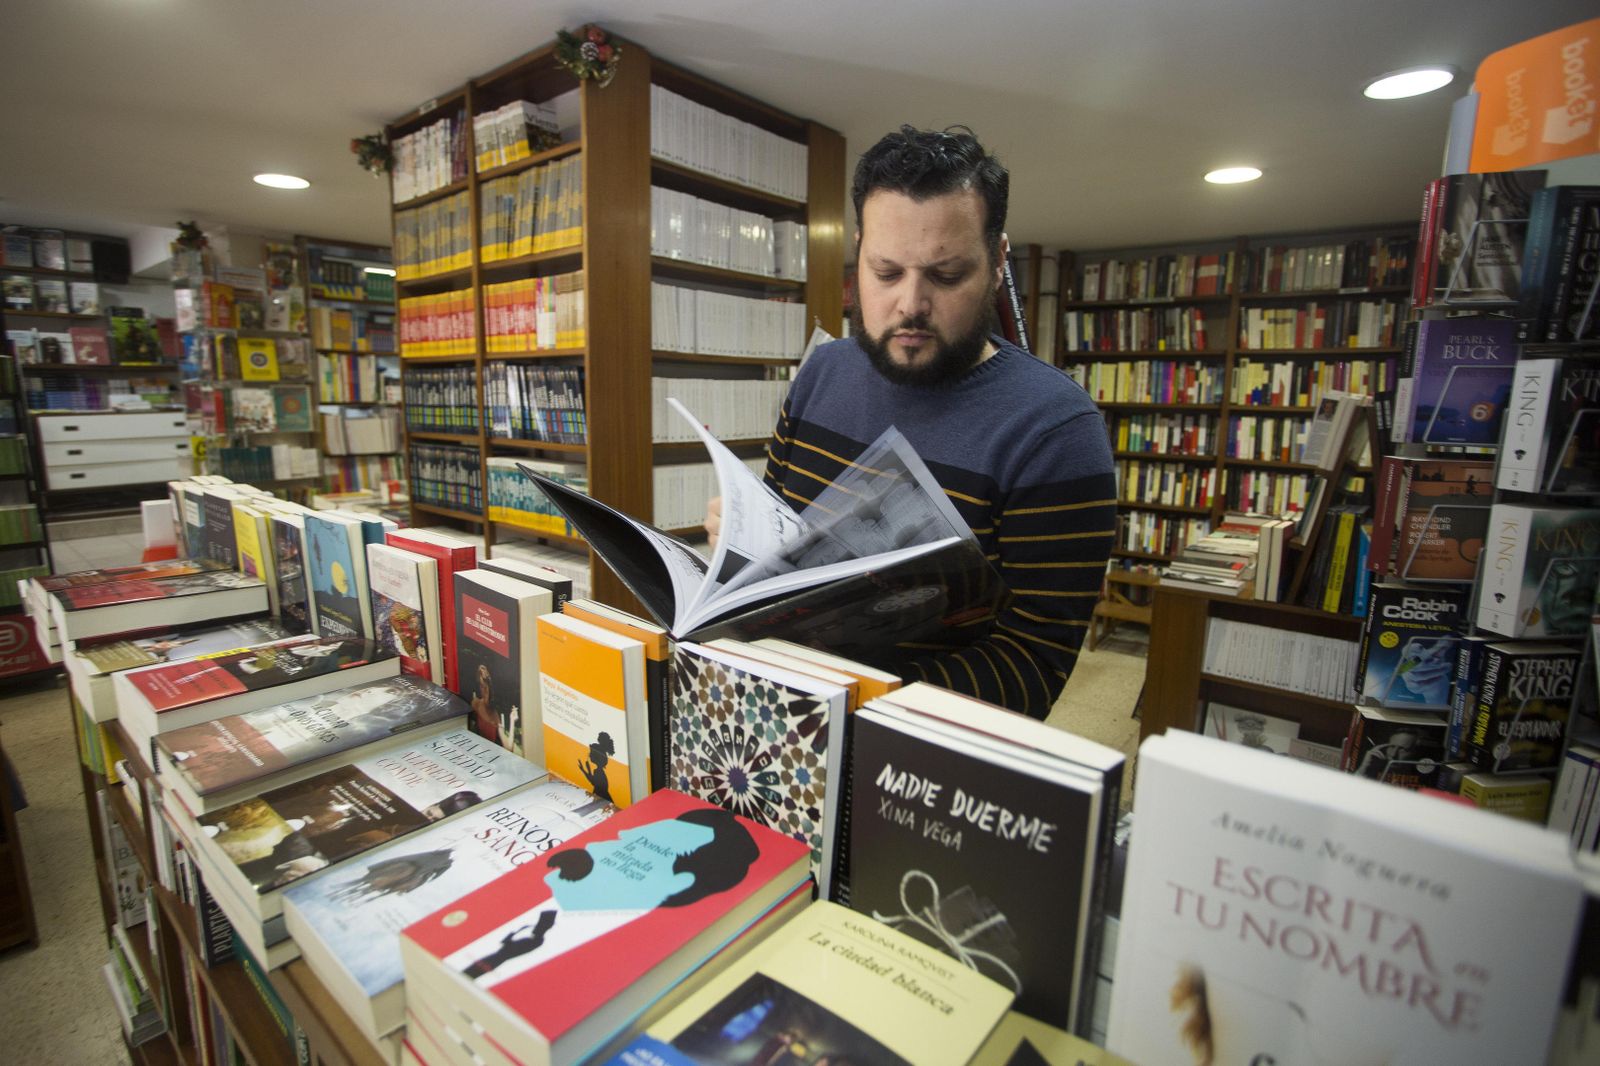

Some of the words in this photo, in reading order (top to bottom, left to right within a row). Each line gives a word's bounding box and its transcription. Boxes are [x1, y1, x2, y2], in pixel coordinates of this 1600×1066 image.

[1442, 345, 1500, 361] BUCK
[1449, 335, 1484, 344] PEARL
[1517, 375, 1541, 427] KING
[1495, 519, 1520, 571] KING
[1508, 658, 1576, 678] STEPHEN
[1508, 675, 1573, 700] KING
[425, 742, 496, 779] SOLEDAD
[446, 733, 481, 753] ERA
[474, 749, 501, 764] LA
[376, 758, 424, 788] CONDE
[401, 752, 467, 789] ALFREDO
[875, 763, 943, 808] NADIE
[948, 785, 1058, 854] DUERME
[877, 796, 916, 832] XINA
[922, 818, 964, 852] VEGA
[474, 827, 538, 868] SANG
[485, 807, 564, 852] REINOS
[623, 842, 636, 852] la
[636, 836, 674, 858] Donde
[600, 856, 617, 867] no
[616, 857, 646, 881] llega
[611, 850, 653, 873] mirada
[1210, 811, 1306, 852] Amelia
[1318, 836, 1453, 903] Noguera
[1210, 856, 1439, 977] ESCRITA
[842, 919, 897, 952] KAROLINA
[807, 931, 829, 948] La
[830, 940, 892, 978] ciudad
[892, 968, 955, 1016] blanca
[1166, 880, 1229, 932] TU
[1239, 909, 1485, 1034] NOMBRE
